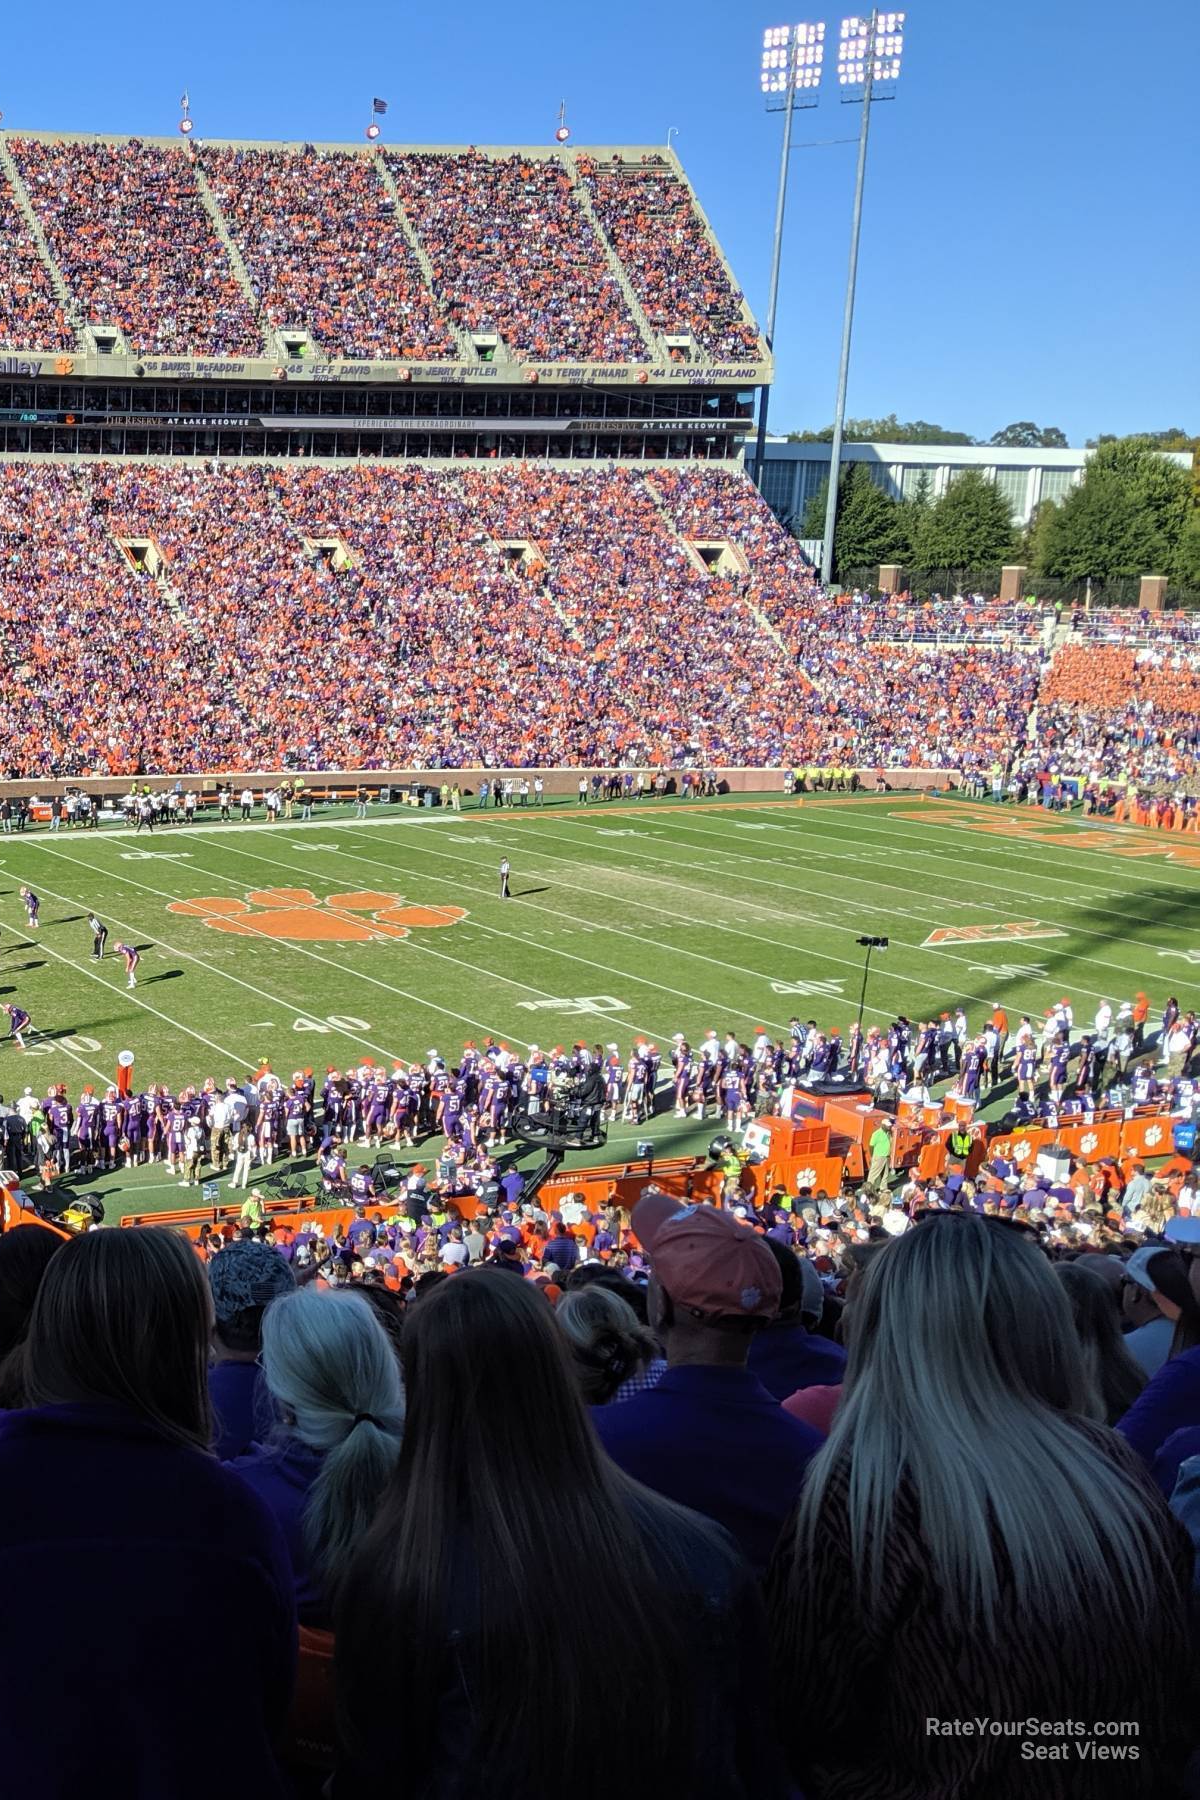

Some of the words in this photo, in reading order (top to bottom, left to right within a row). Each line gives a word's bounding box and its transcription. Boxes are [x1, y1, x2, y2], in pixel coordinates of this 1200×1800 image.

[161, 362, 191, 371] BANKS
[197, 363, 246, 373] McFADDEN
[309, 366, 335, 374] JEFF
[341, 366, 371, 375] DAVIS
[426, 367, 457, 376] JERRY
[461, 367, 497, 377] BUTLER
[556, 369, 586, 377] TERRY
[591, 369, 628, 378] KINARD
[670, 369, 703, 378] LEVON
[706, 369, 757, 378] KIRKLAND
[106, 416, 125, 425] THE
[125, 417, 163, 426] RESERVE
[212, 418, 249, 426] KEOWEE
[352, 419, 397, 428] EXPERIENCE
[400, 419, 414, 428] THE
[416, 420, 476, 428] EXTRAORDINARY
[580, 420, 600, 430] THE
[600, 421, 638, 431] RESERVE
[660, 422, 682, 430] LAKE
[688, 422, 727, 430] KEOWEE
[921, 921, 1064, 946] ACC
[968, 963, 1049, 980] 30
[770, 978, 848, 996] 40
[292, 1015, 371, 1034] 40
[969, 1058, 979, 1070] 10
[725, 1077, 740, 1089] 27
[376, 1090, 389, 1102] 31
[129, 1103, 141, 1117] 40
[449, 1100, 460, 1112] 51
[1026, 1103, 1035, 1116] 5
[1049, 1105, 1058, 1116] 3
[60, 1111, 68, 1124] 3
[87, 1110, 95, 1123] 7
[173, 1119, 185, 1131] 81
